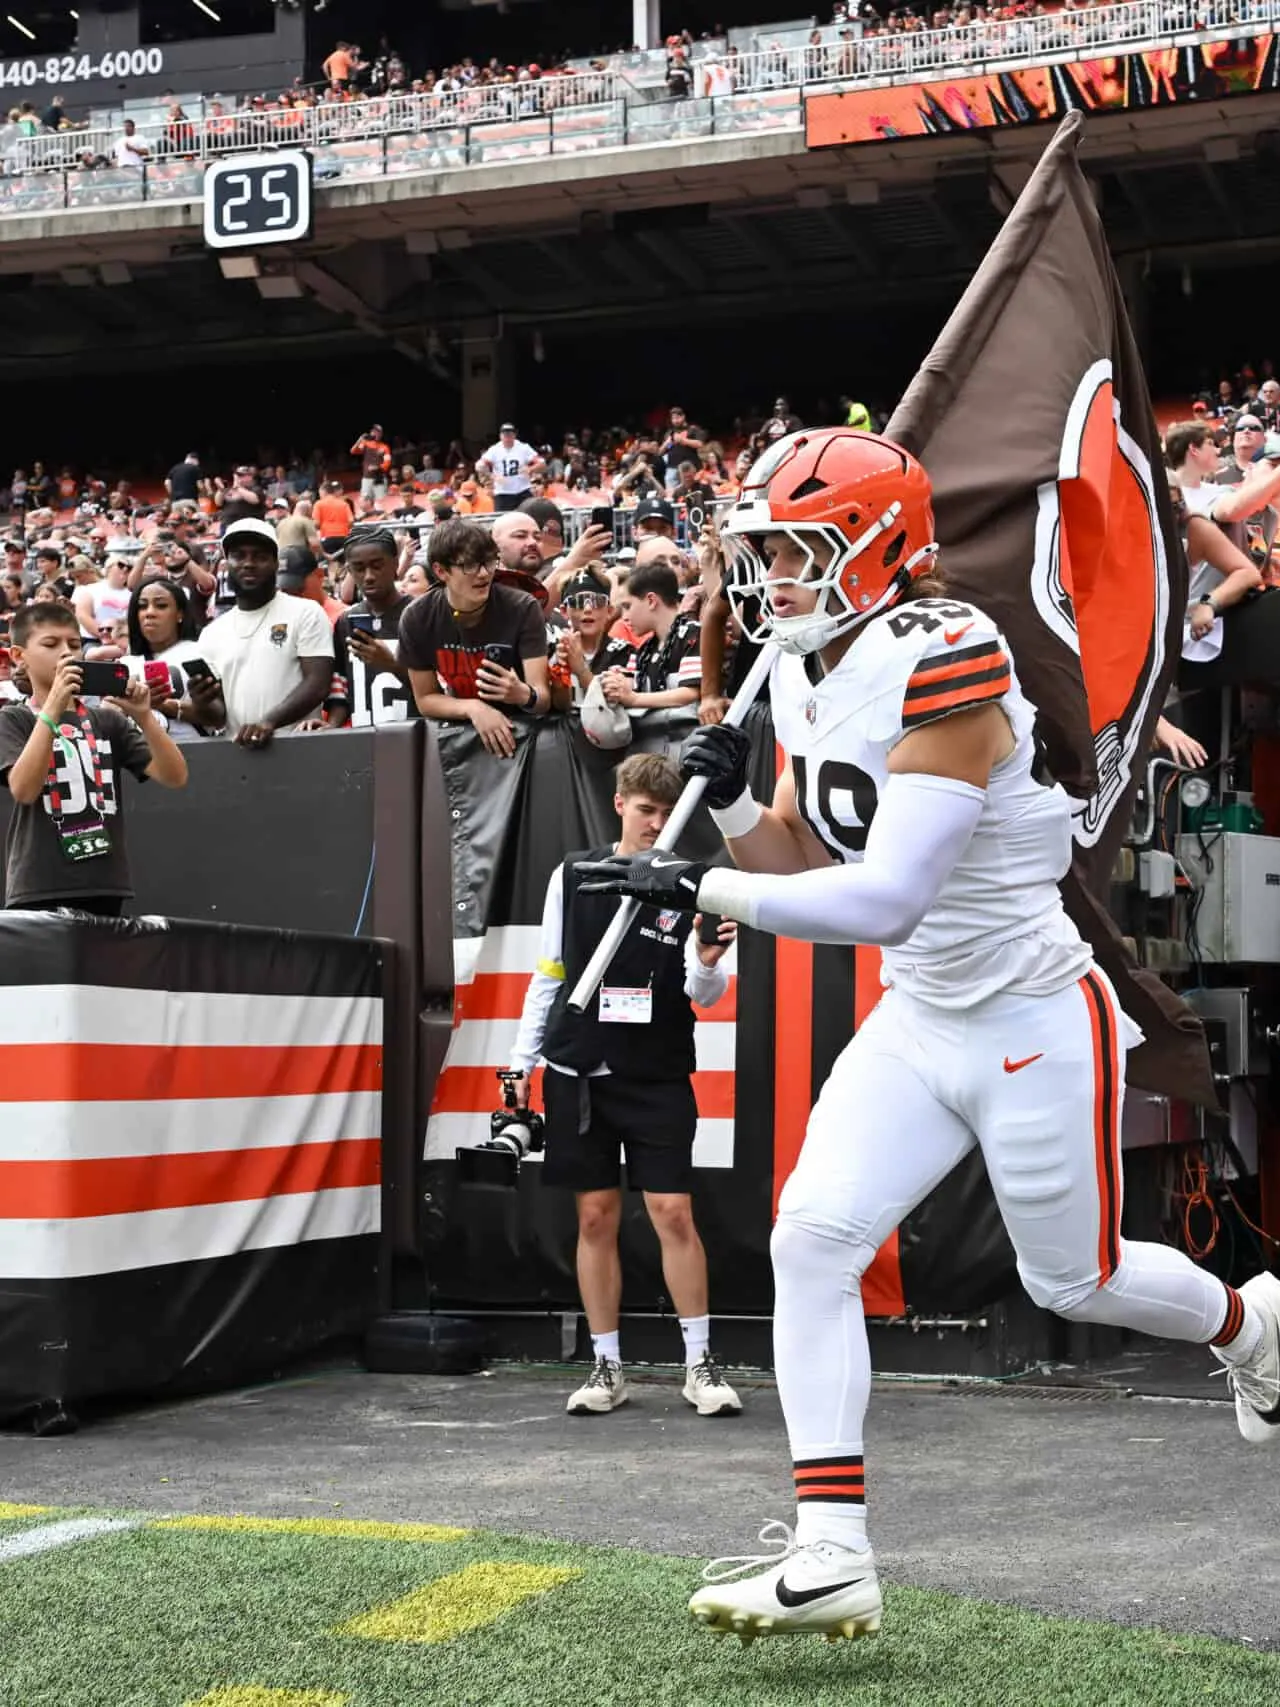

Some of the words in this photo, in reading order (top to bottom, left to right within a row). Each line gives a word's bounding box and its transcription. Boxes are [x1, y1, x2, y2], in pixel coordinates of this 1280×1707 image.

[223, 169, 291, 231] 25
[503, 459, 520, 477] 12
[887, 600, 973, 638] 49
